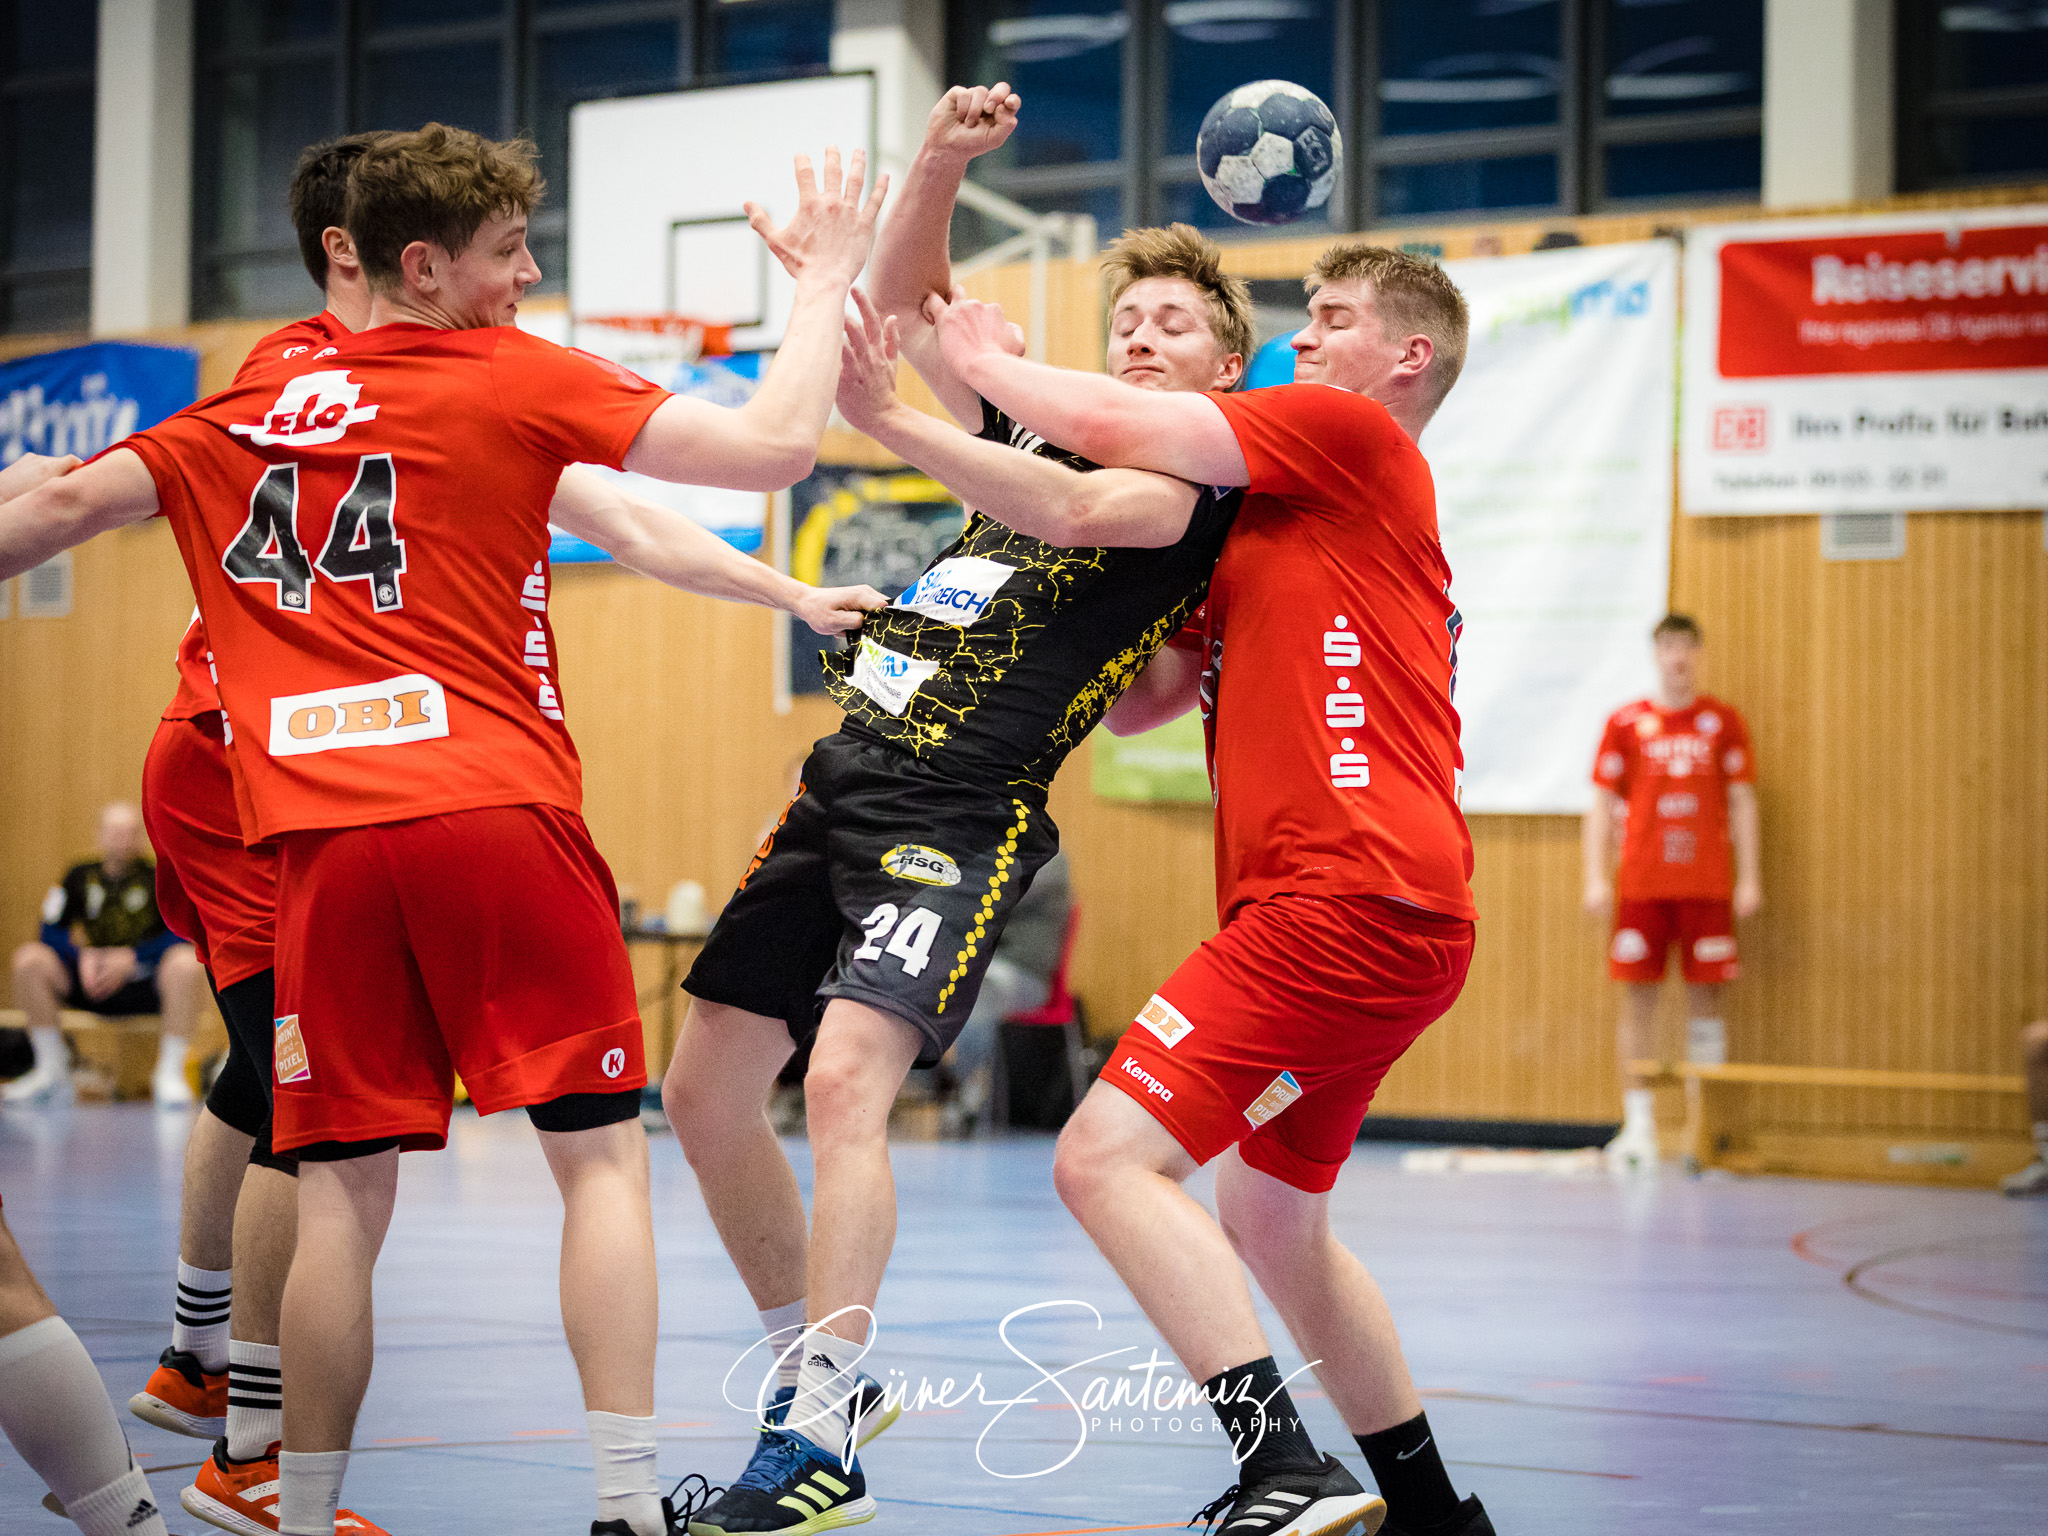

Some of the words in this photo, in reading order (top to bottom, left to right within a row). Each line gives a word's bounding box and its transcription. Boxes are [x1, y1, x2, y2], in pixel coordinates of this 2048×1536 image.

[221, 452, 408, 614] 44
[288, 690, 431, 739] OBI
[900, 855, 945, 874] HSG
[853, 903, 943, 978] 24
[279, 1052, 303, 1073] PIXEL
[1120, 1056, 1174, 1103] Kempa
